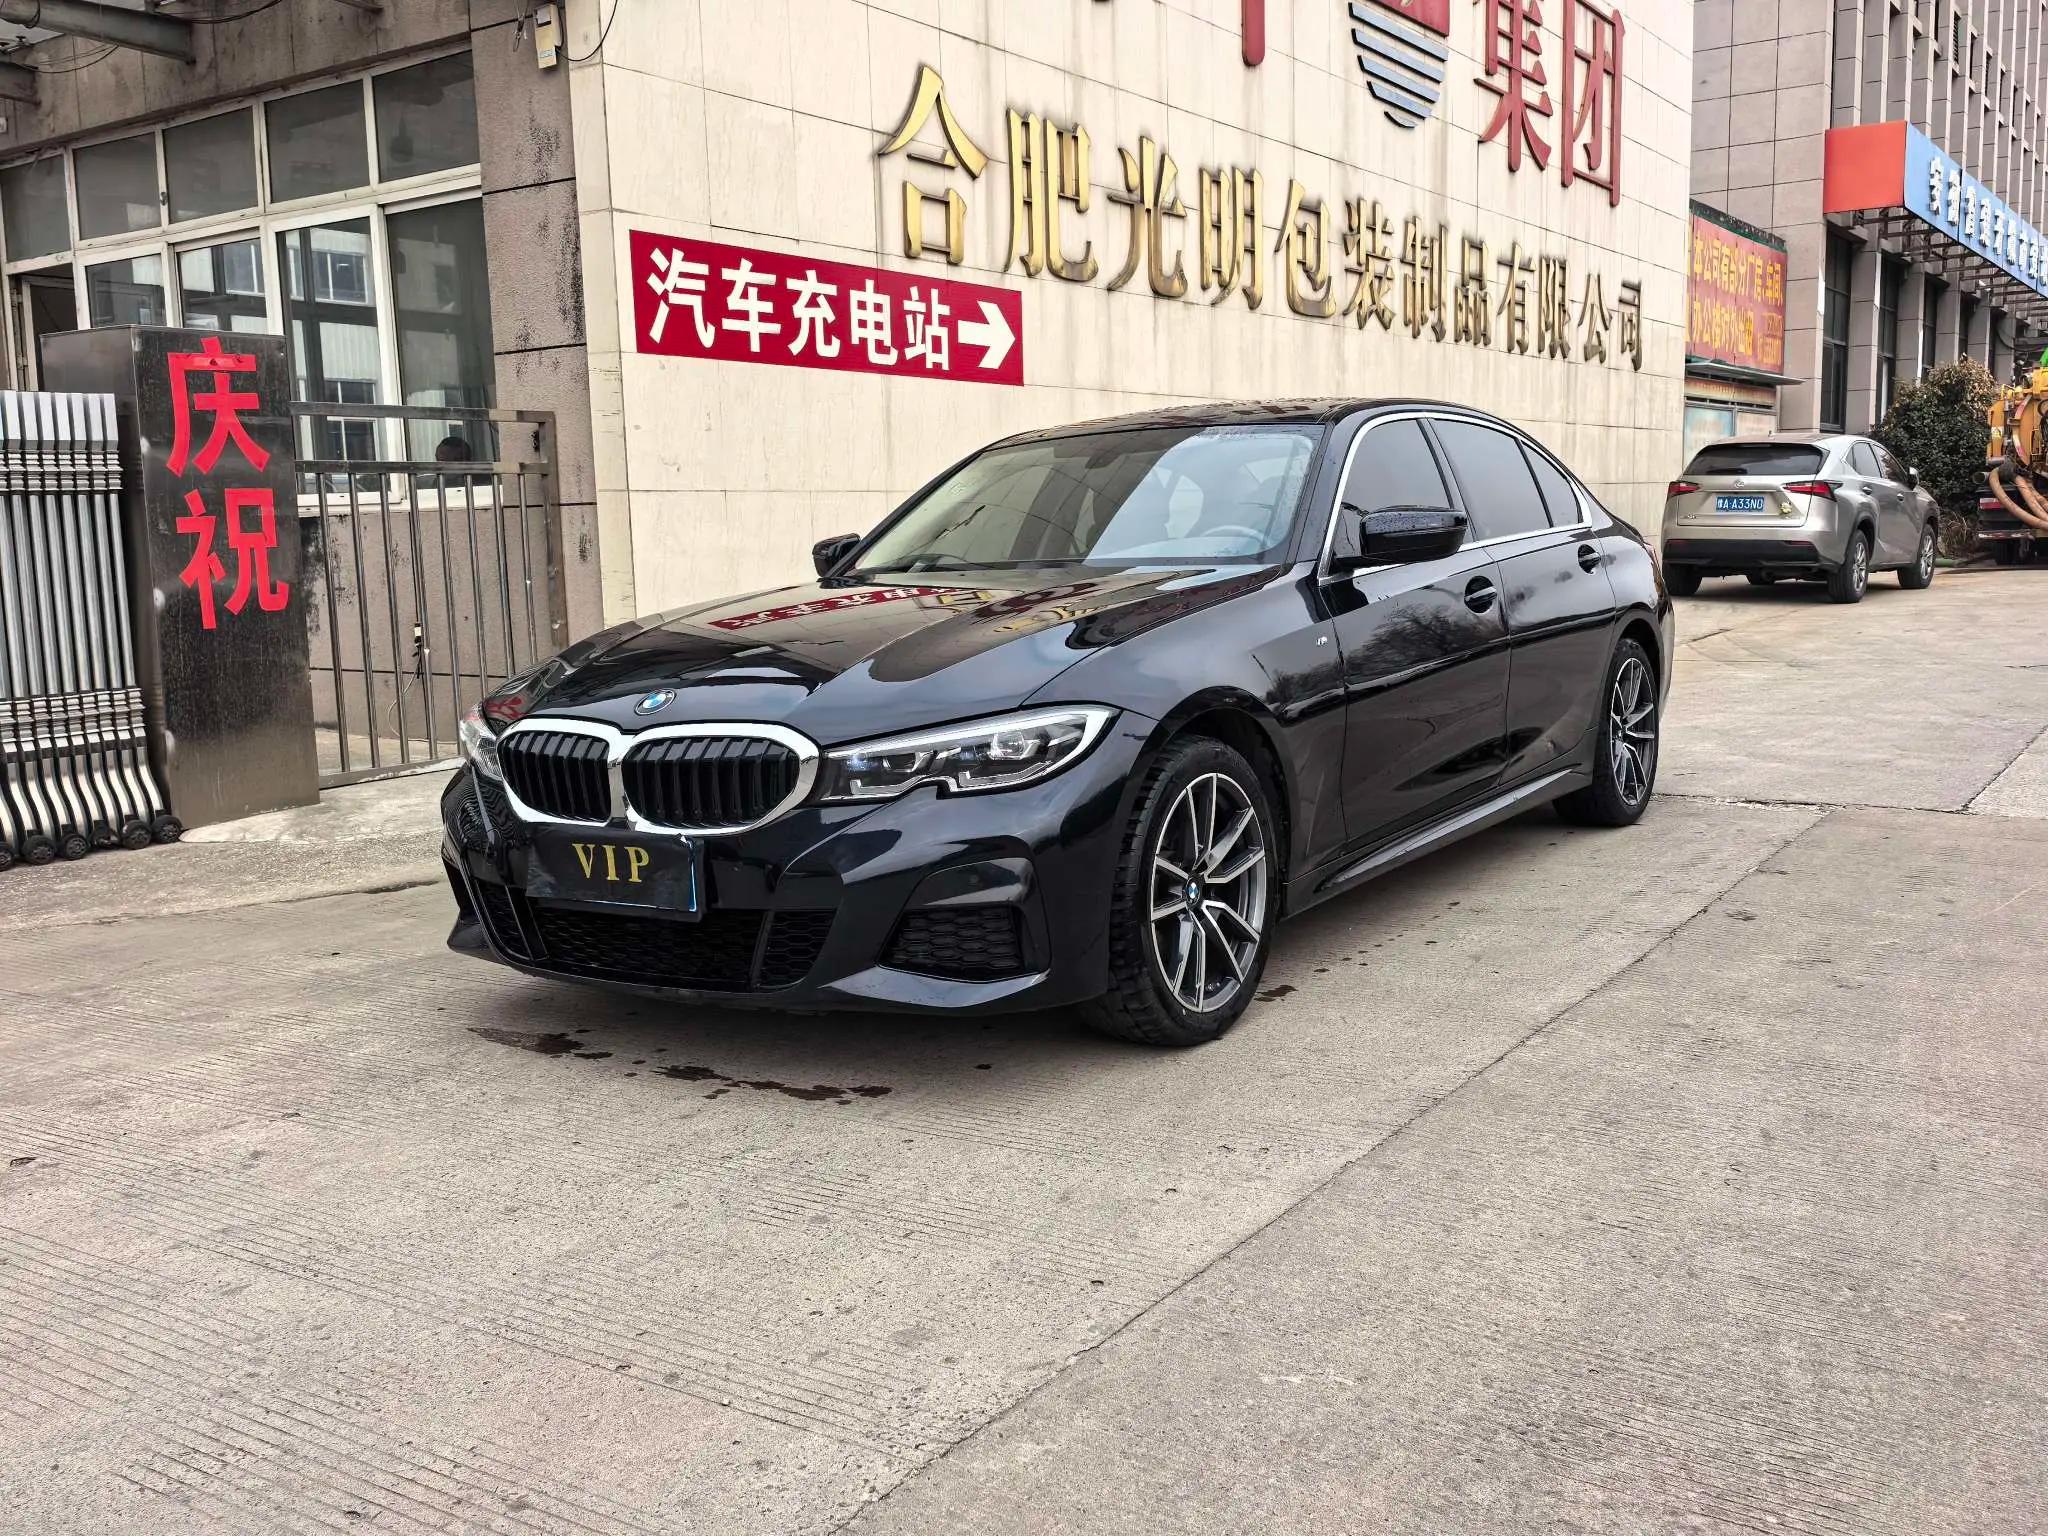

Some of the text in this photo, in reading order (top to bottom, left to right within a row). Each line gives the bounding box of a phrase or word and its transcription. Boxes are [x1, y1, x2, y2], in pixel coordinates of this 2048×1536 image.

[1473, 0, 1624, 206] 集团
[647, 248, 950, 370] 汽车充电站
[879, 64, 1642, 371] 合肥光明包装制品有限公司
[166, 336, 289, 629] 庆祝
[572, 843, 649, 883] VIP
